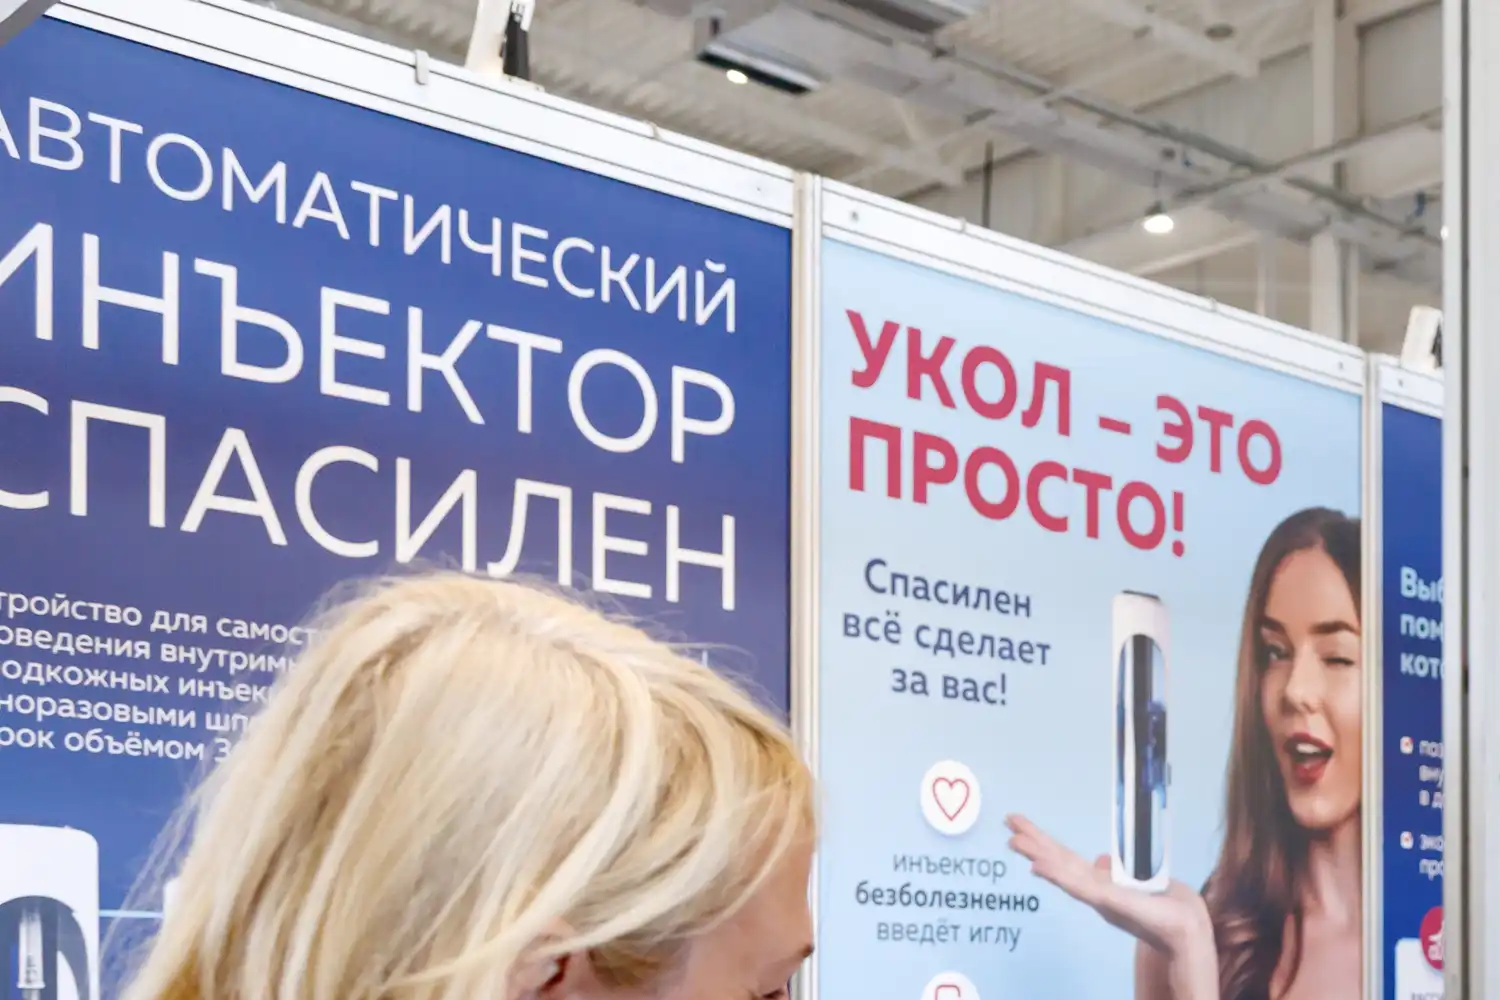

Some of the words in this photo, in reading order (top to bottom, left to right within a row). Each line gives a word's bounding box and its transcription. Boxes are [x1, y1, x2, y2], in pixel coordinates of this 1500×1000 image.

[845, 308, 1071, 437] УКОЛ
[1156, 394, 1283, 486] ЭТО
[849, 415, 1185, 558] ПРОСТО!
[863, 558, 1032, 619] Спасилен
[151, 609, 208, 635] для
[842, 609, 902, 646] всё
[914, 622, 1052, 667] сделает
[1, 660, 169, 694] одкожных
[890, 666, 930, 698] за
[941, 671, 1008, 707] вас!
[64, 728, 205, 761] объёмом
[892, 853, 1007, 884] инъектор
[855, 880, 1040, 913] безболезненно
[876, 917, 961, 945] введёт
[969, 924, 1022, 952] иглу
